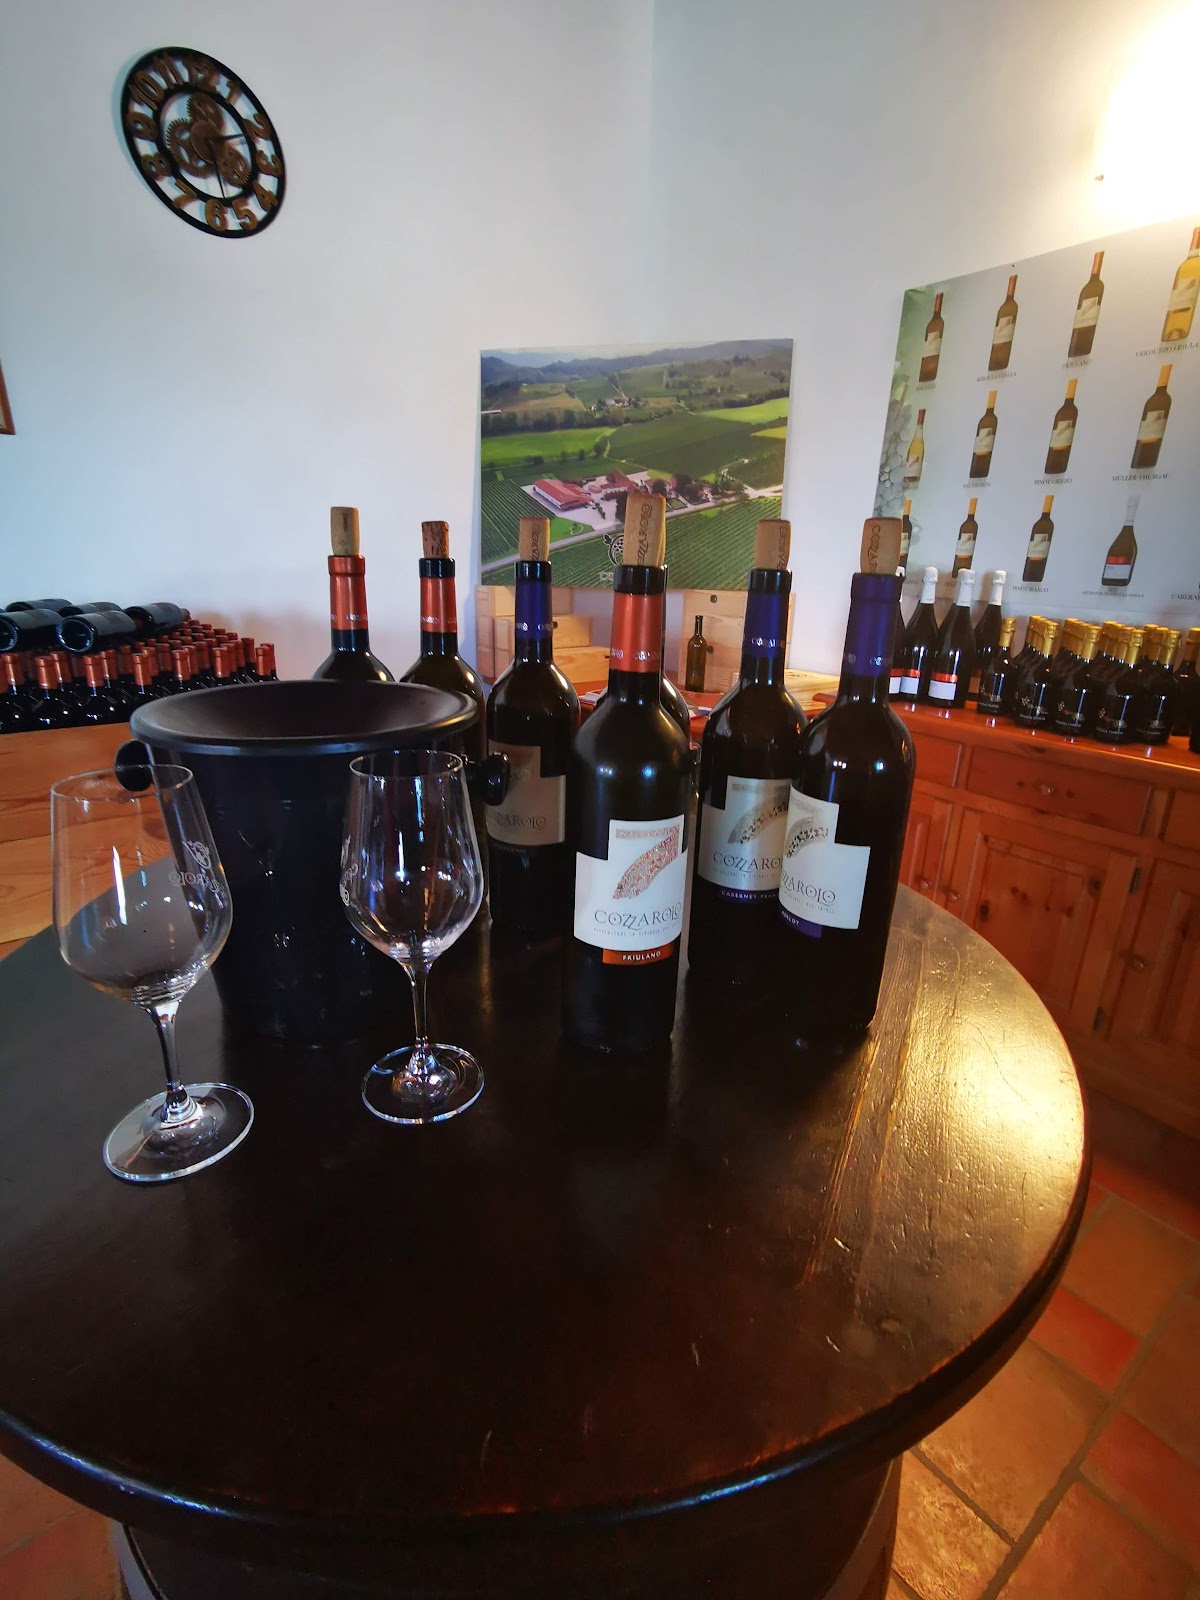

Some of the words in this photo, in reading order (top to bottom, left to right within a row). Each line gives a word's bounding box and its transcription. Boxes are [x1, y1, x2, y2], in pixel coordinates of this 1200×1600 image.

[128, 69, 165, 111] 10
[127, 111, 158, 140] 9
[244, 113, 272, 143] 2
[142, 152, 172, 181] 8
[256, 150, 282, 176] 3
[173, 178, 198, 209] 7
[252, 179, 279, 212] 4
[205, 199, 229, 231] 6
[232, 199, 258, 231] 5
[622, 950, 661, 961] FRIULANO
